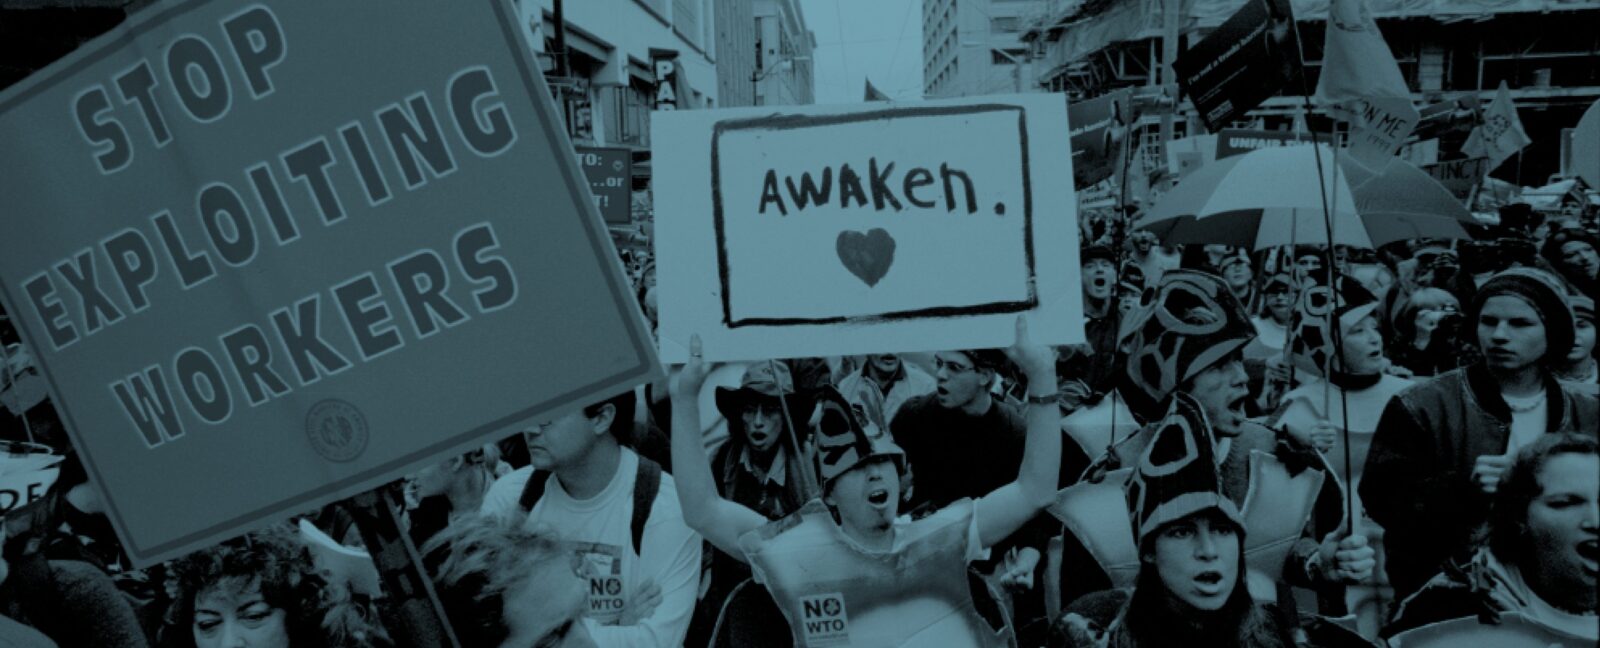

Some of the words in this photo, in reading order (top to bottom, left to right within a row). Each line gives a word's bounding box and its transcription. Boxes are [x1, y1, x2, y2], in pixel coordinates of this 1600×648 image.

[75, 5, 286, 175] STOP
[575, 153, 602, 166] TO:
[20, 66, 517, 351] EXPLOITING
[110, 222, 517, 449] WORKERS
[590, 577, 621, 596] NO
[590, 598, 624, 610] WTO
[803, 598, 841, 618] NO
[805, 619, 844, 634] WTO
